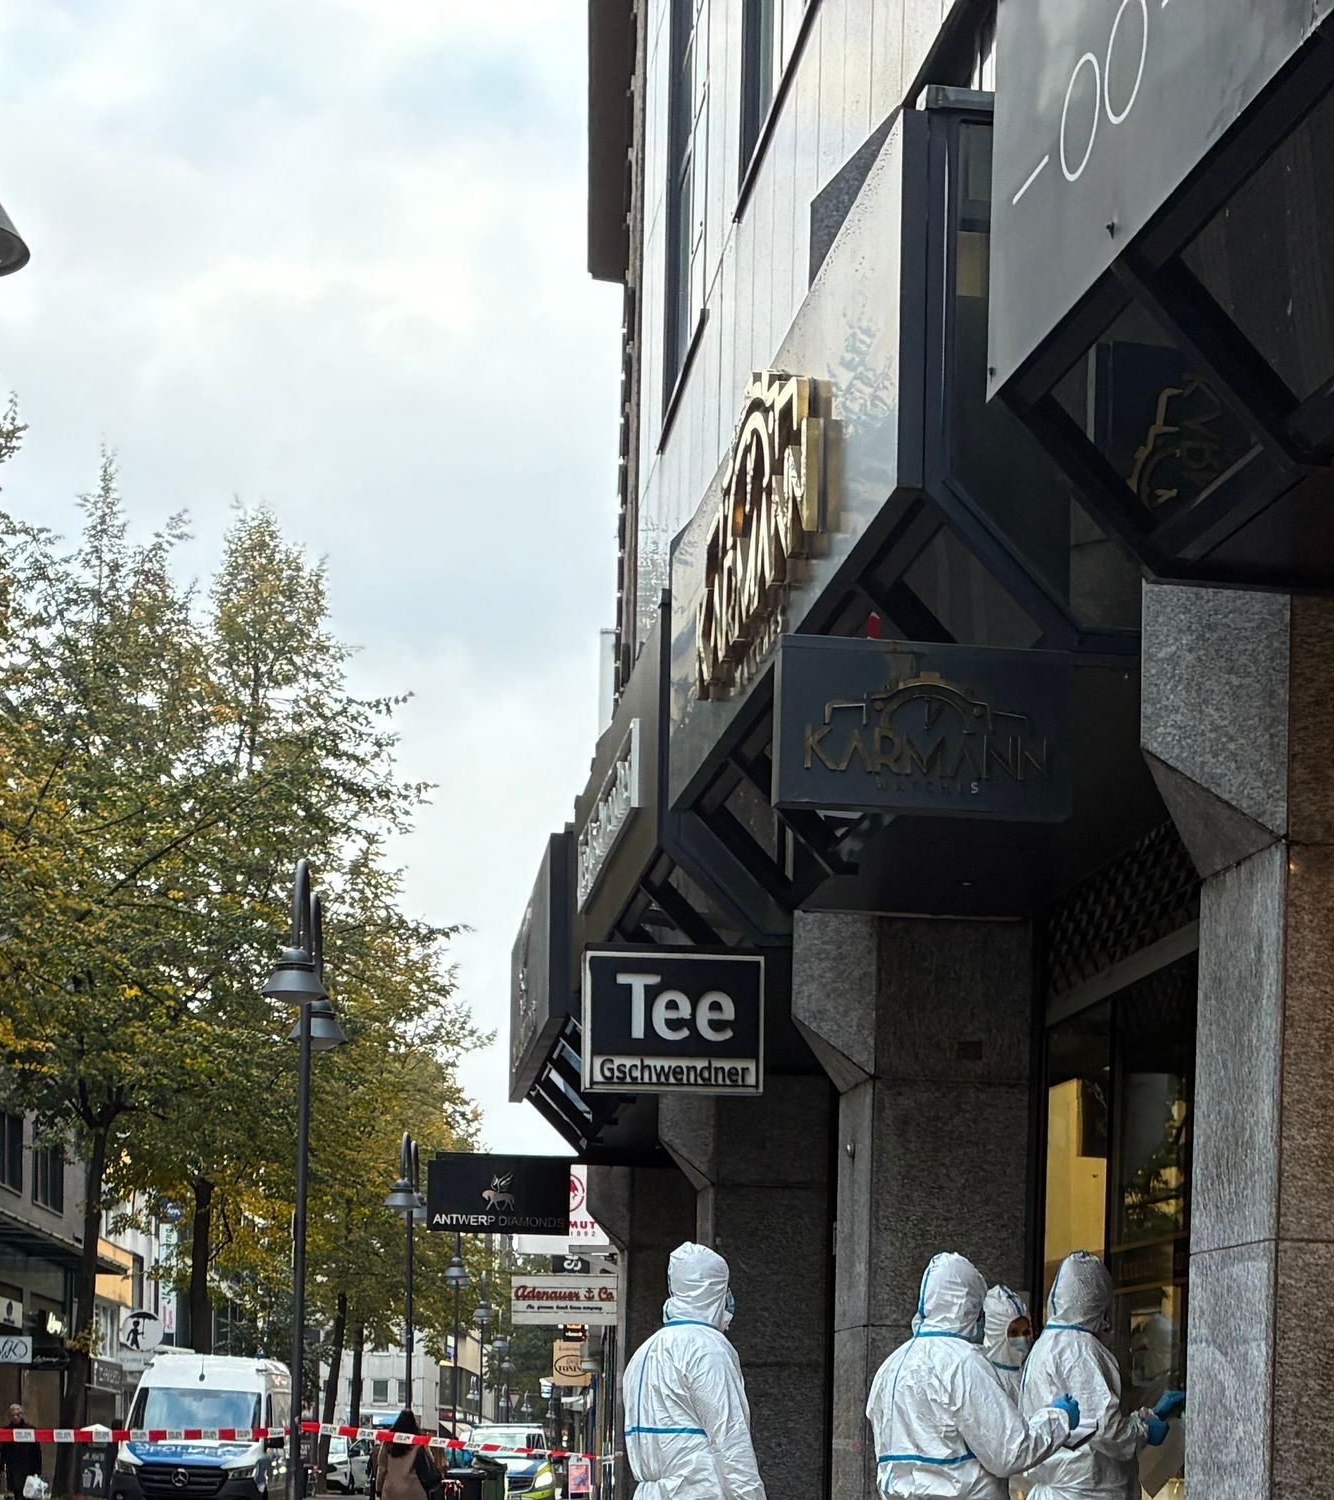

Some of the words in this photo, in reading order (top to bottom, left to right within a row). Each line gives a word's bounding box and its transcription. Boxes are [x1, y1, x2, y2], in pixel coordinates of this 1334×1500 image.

[802, 724, 1049, 782] KARMANN
[616, 973, 735, 1041] Tee
[599, 1057, 750, 1085] Gschwendner
[432, 1213, 496, 1226] ANTWERP
[498, 1215, 565, 1229] DIAMONDS
[514, 1284, 581, 1301] Adenauer
[598, 1286, 615, 1302] Co
